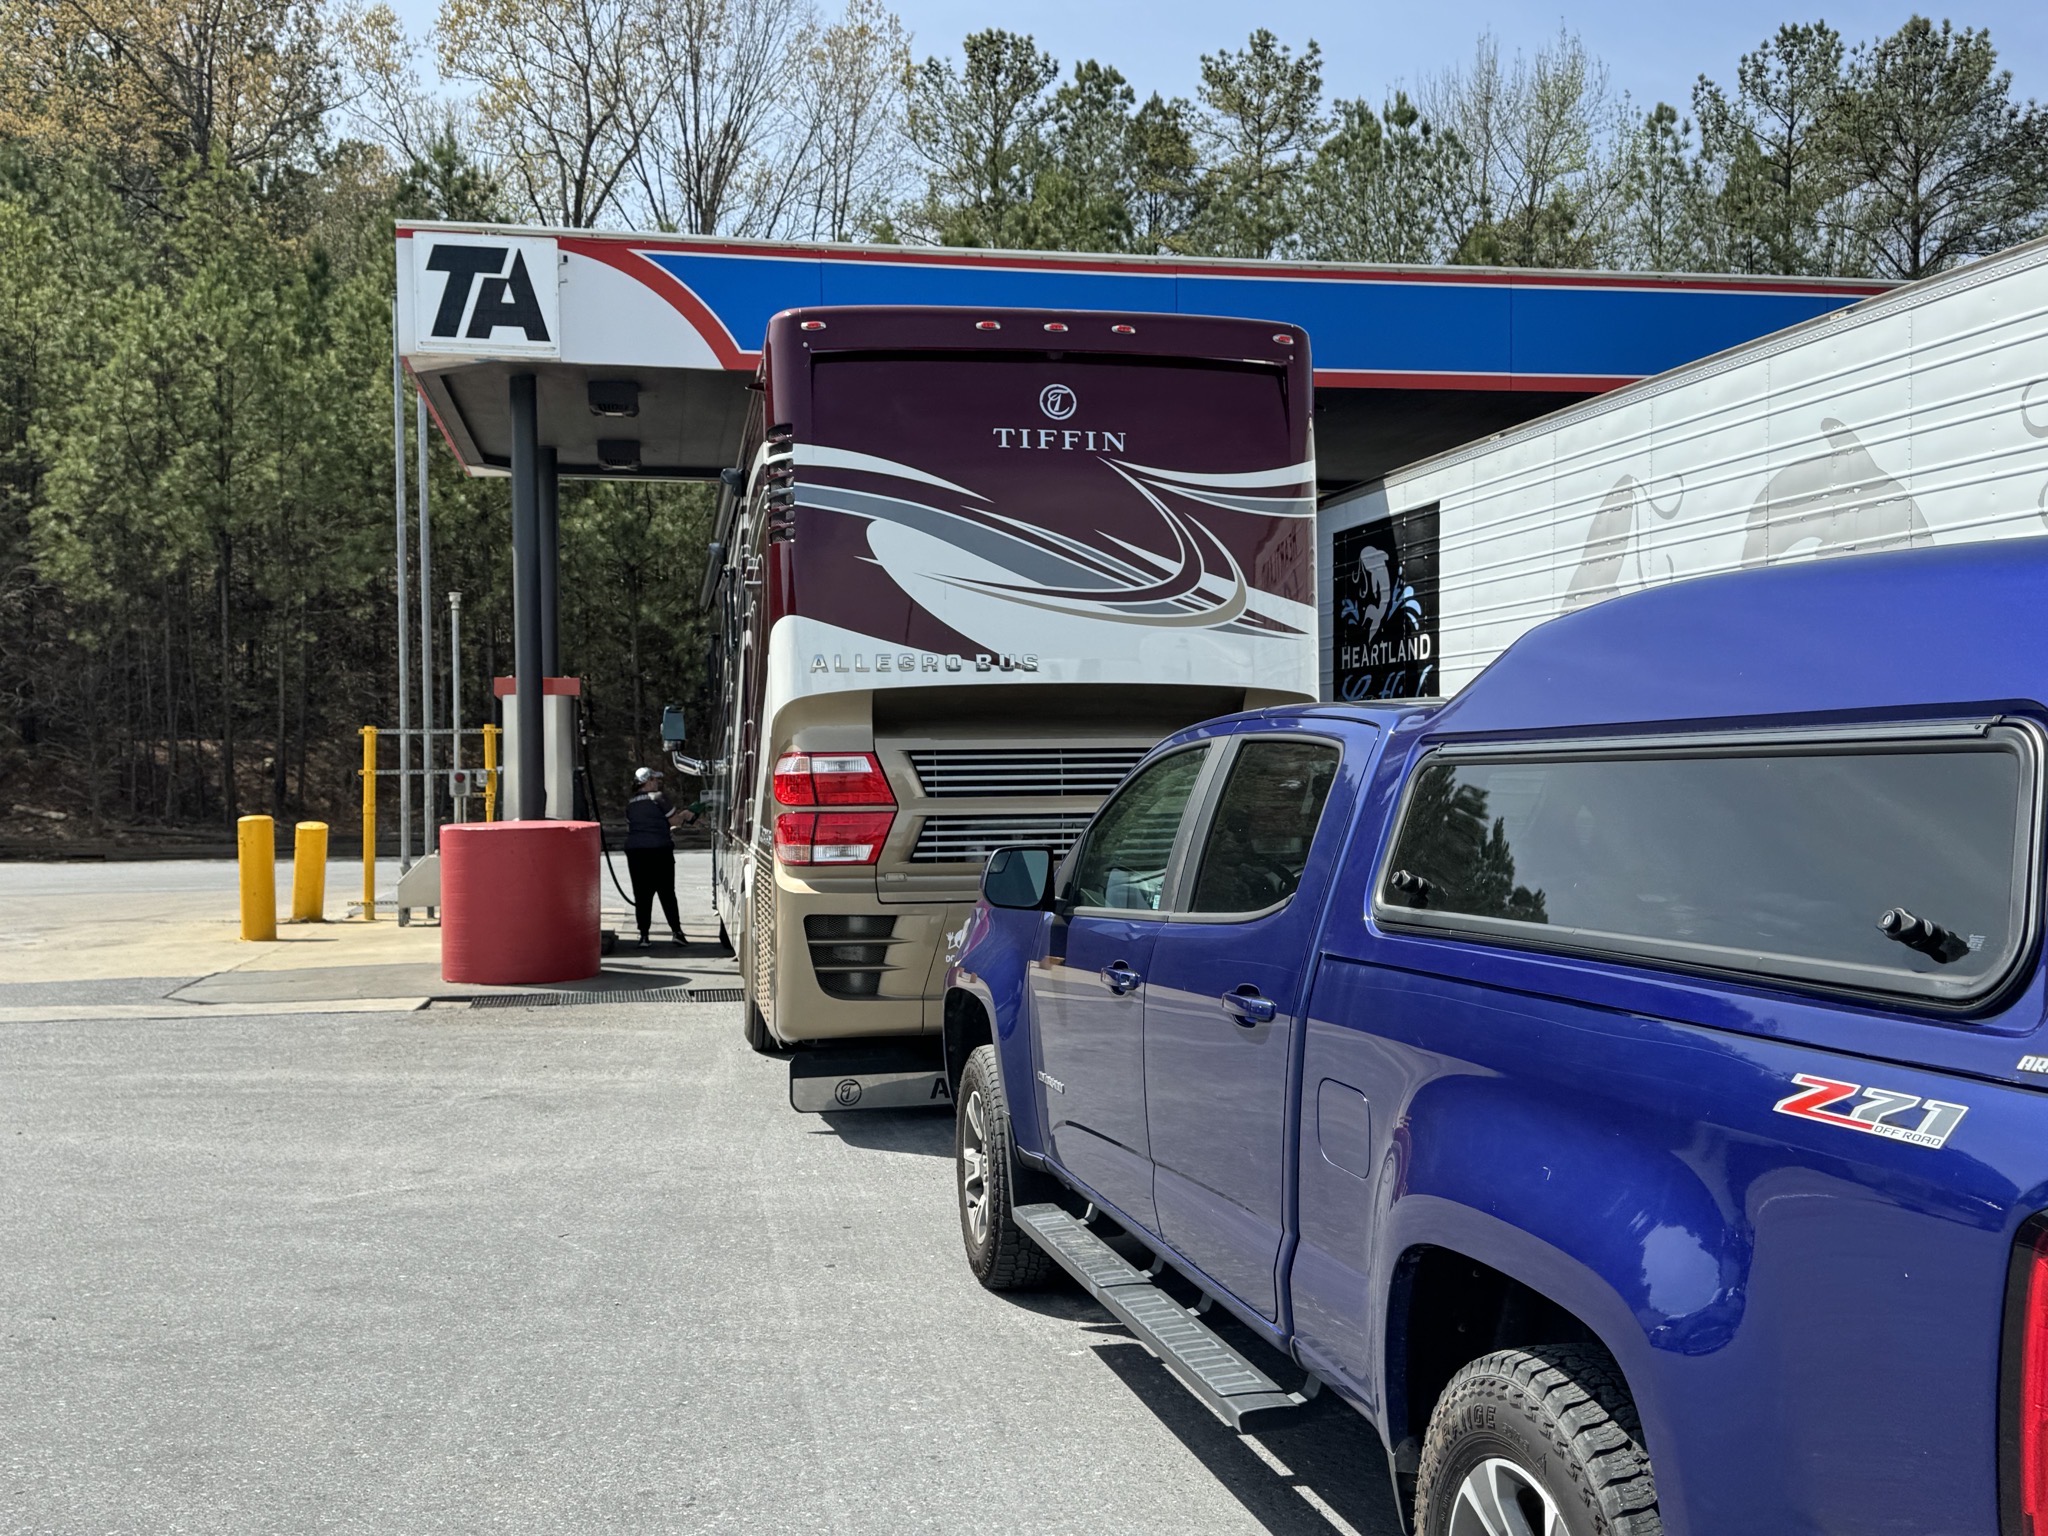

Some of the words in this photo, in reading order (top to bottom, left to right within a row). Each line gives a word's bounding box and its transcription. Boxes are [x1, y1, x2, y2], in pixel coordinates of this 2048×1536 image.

[425, 244, 551, 342] TA
[992, 427, 1126, 453] TIFFIN
[810, 652, 963, 673] ALLEGRO
[975, 652, 1039, 673] BUS
[1341, 633, 1431, 669] HEARTLAND
[1773, 1073, 1969, 1139] Z71
[1874, 1125, 1899, 1137] OFF
[1902, 1131, 1942, 1147] ROAD
